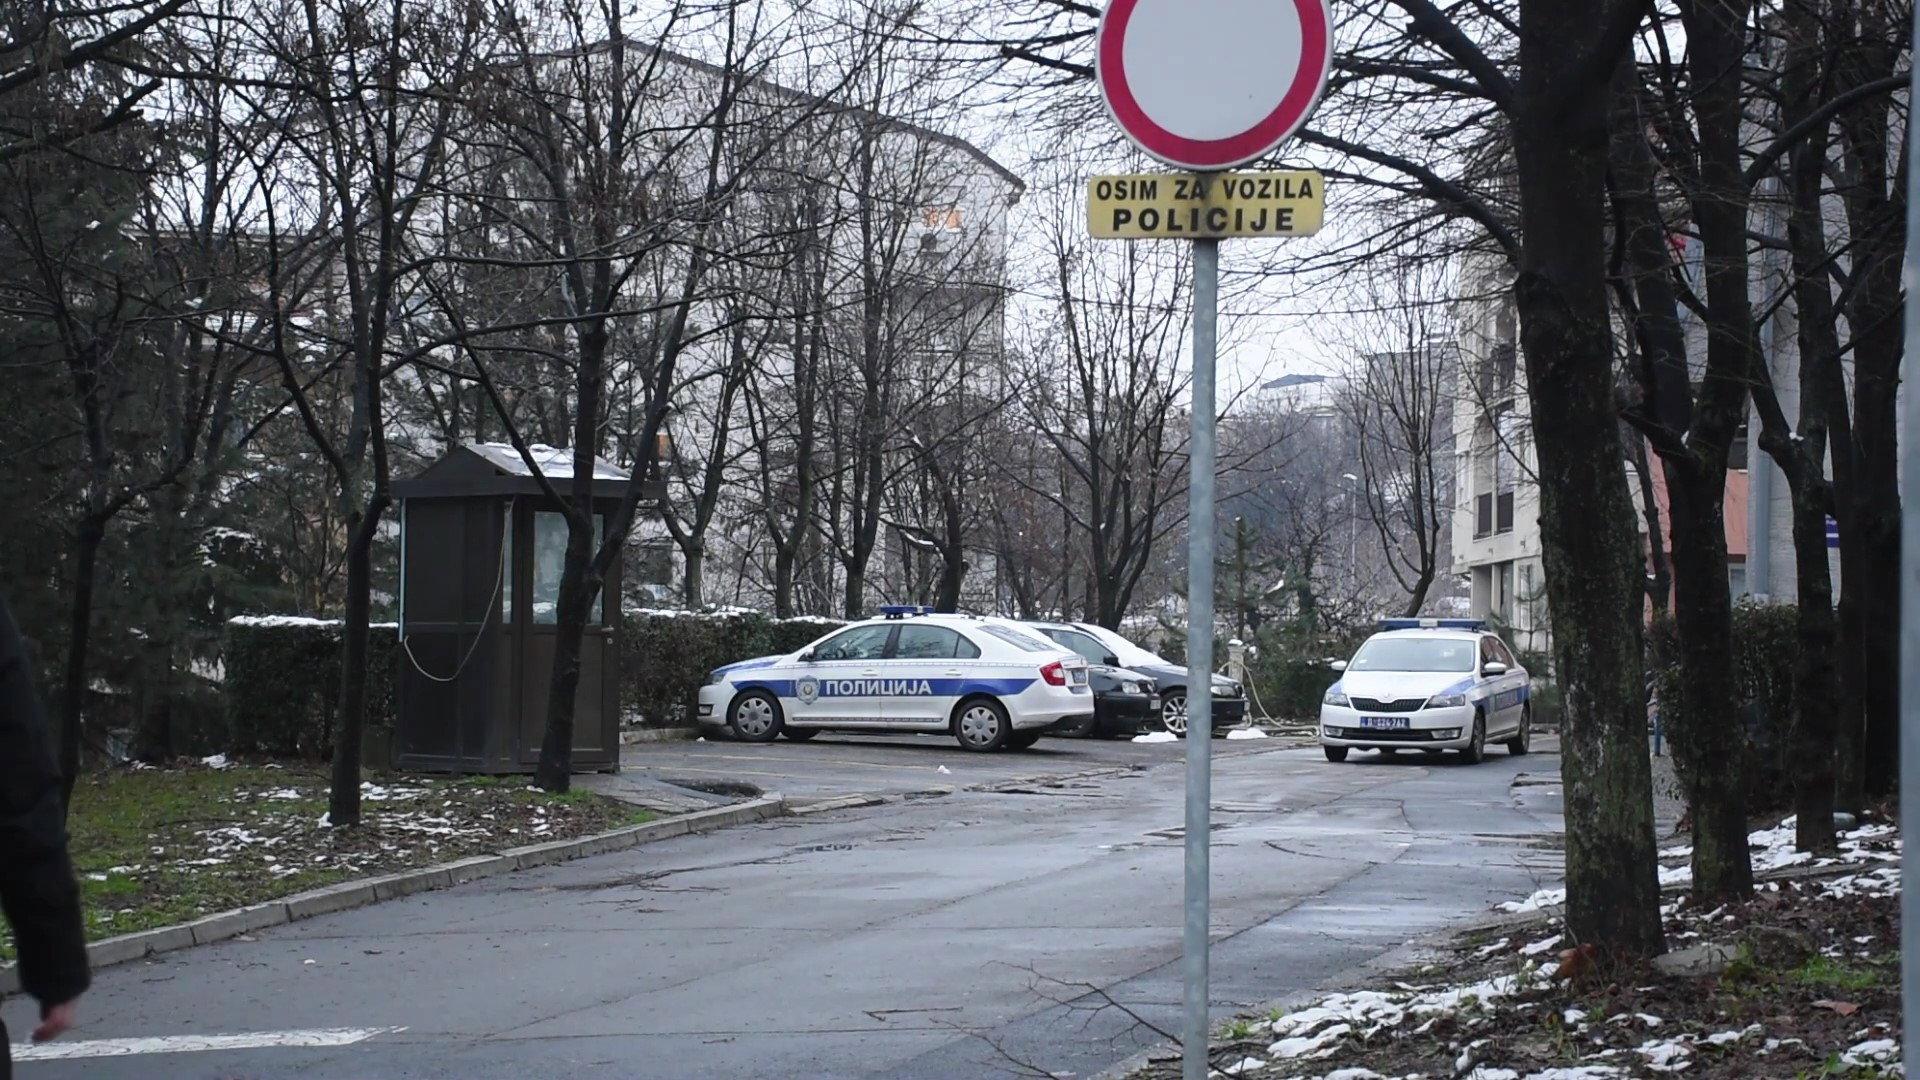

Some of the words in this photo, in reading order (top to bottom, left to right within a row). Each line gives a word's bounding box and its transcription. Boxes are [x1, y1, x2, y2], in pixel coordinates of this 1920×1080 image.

[1096, 180, 1157, 200] OSIM
[1174, 180, 1206, 200] ZA
[1222, 178, 1313, 199] VOZILA
[1112, 207, 1293, 232] POLICIJE
[826, 680, 932, 695] ПОЛИЦИЈА
